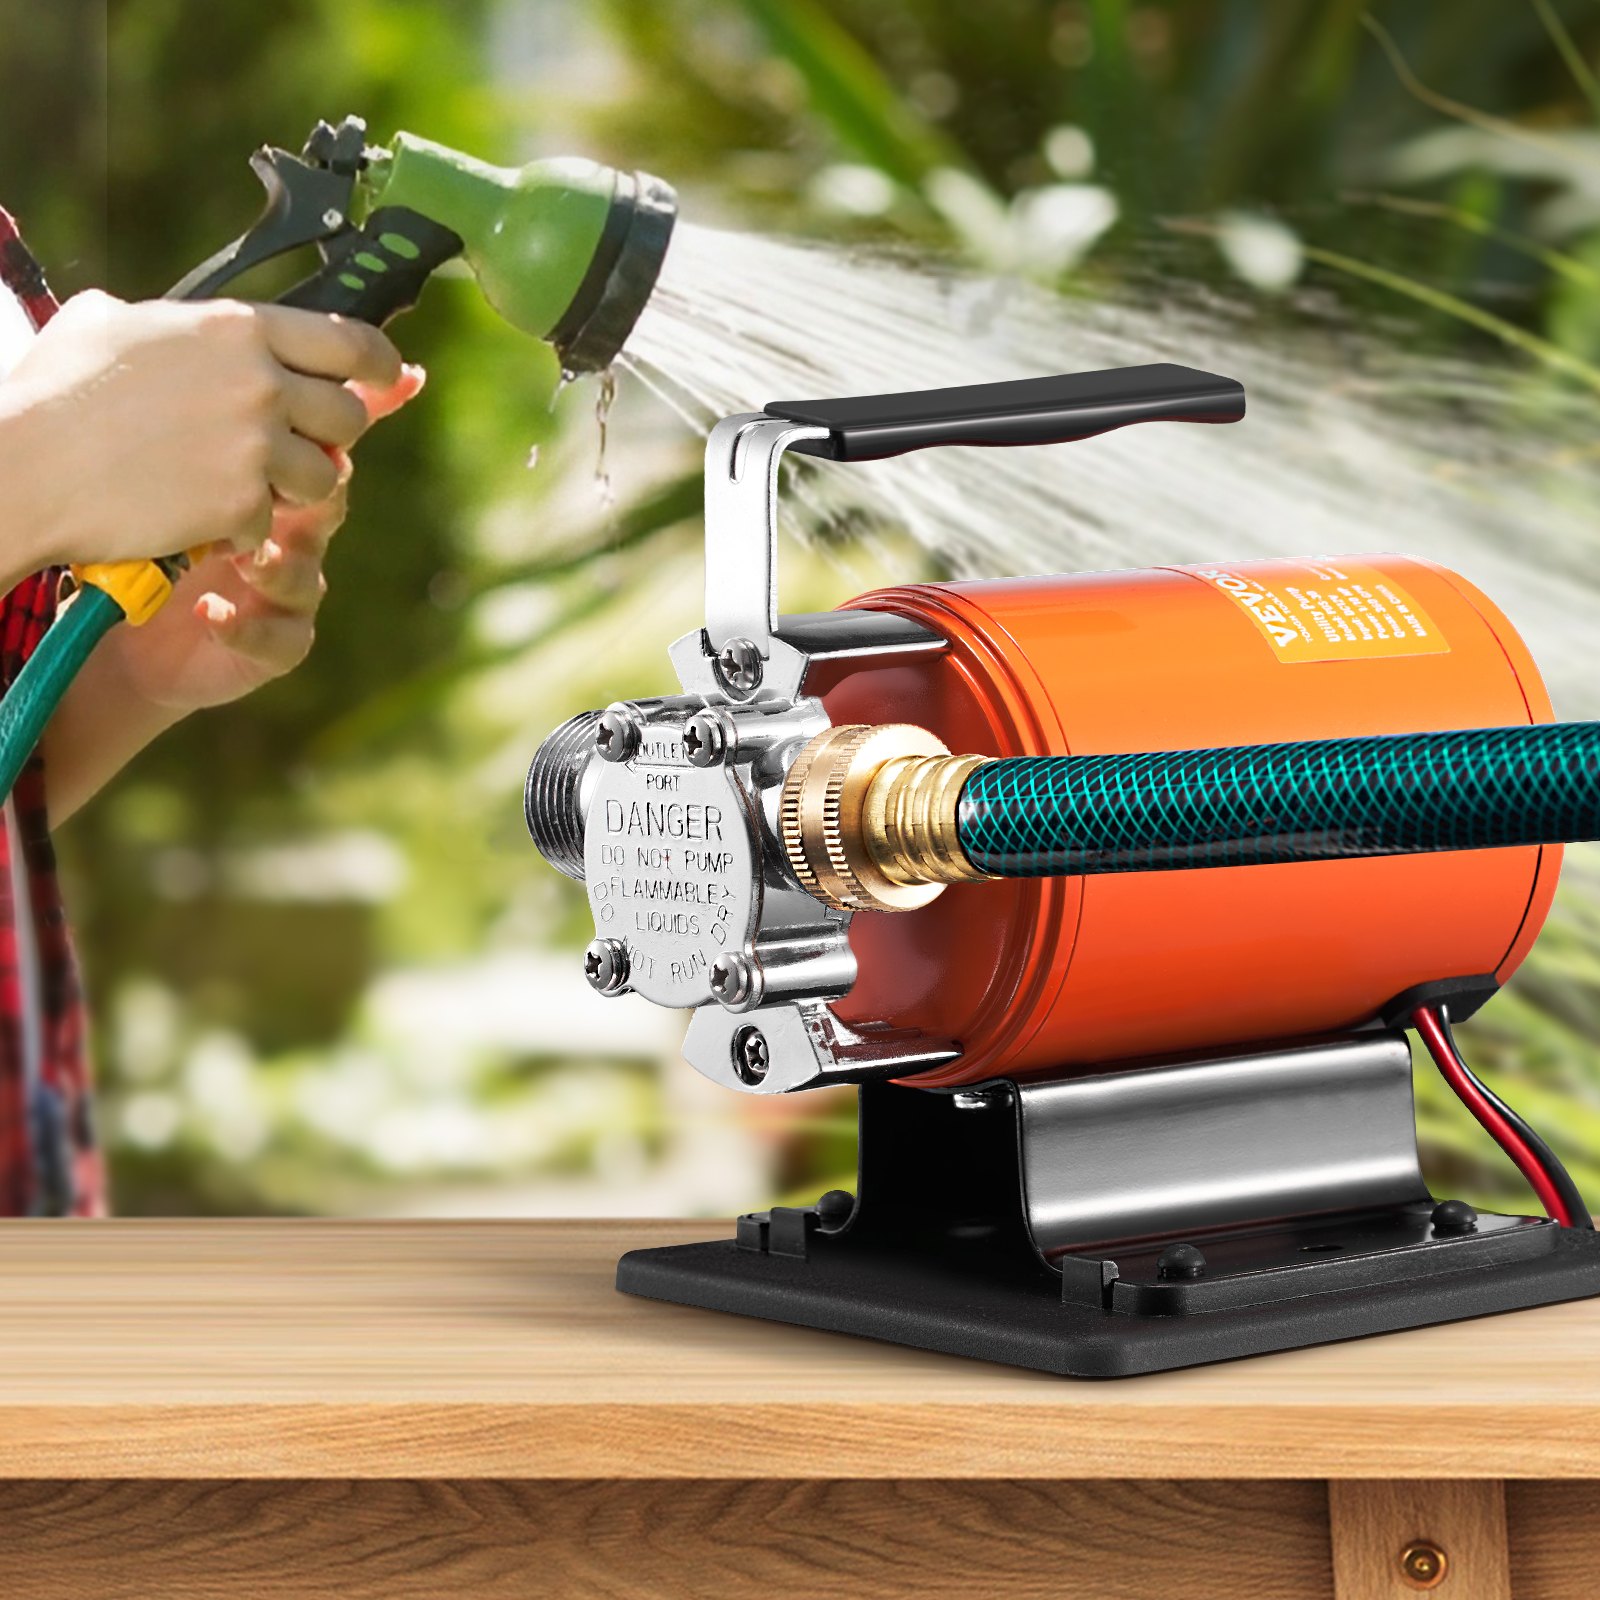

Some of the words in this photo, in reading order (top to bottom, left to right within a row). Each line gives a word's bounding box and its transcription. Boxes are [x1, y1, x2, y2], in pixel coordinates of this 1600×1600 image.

[1196, 570, 1298, 648] VEVOR
[1285, 587, 1316, 610] Pump
[1310, 610, 1341, 643] Utility
[1403, 613, 1428, 637] MADE
[646, 773, 681, 792] PORT
[606, 799, 723, 841] DANGER
[601, 844, 625, 866] DO
[637, 847, 672, 871] NOT
[685, 850, 734, 873] PUMP
[610, 876, 718, 905] FLAMMABLE
[635, 911, 700, 936] LIQUIDS
[671, 949, 707, 983] RUN
[710, 884, 737, 946] DRY
